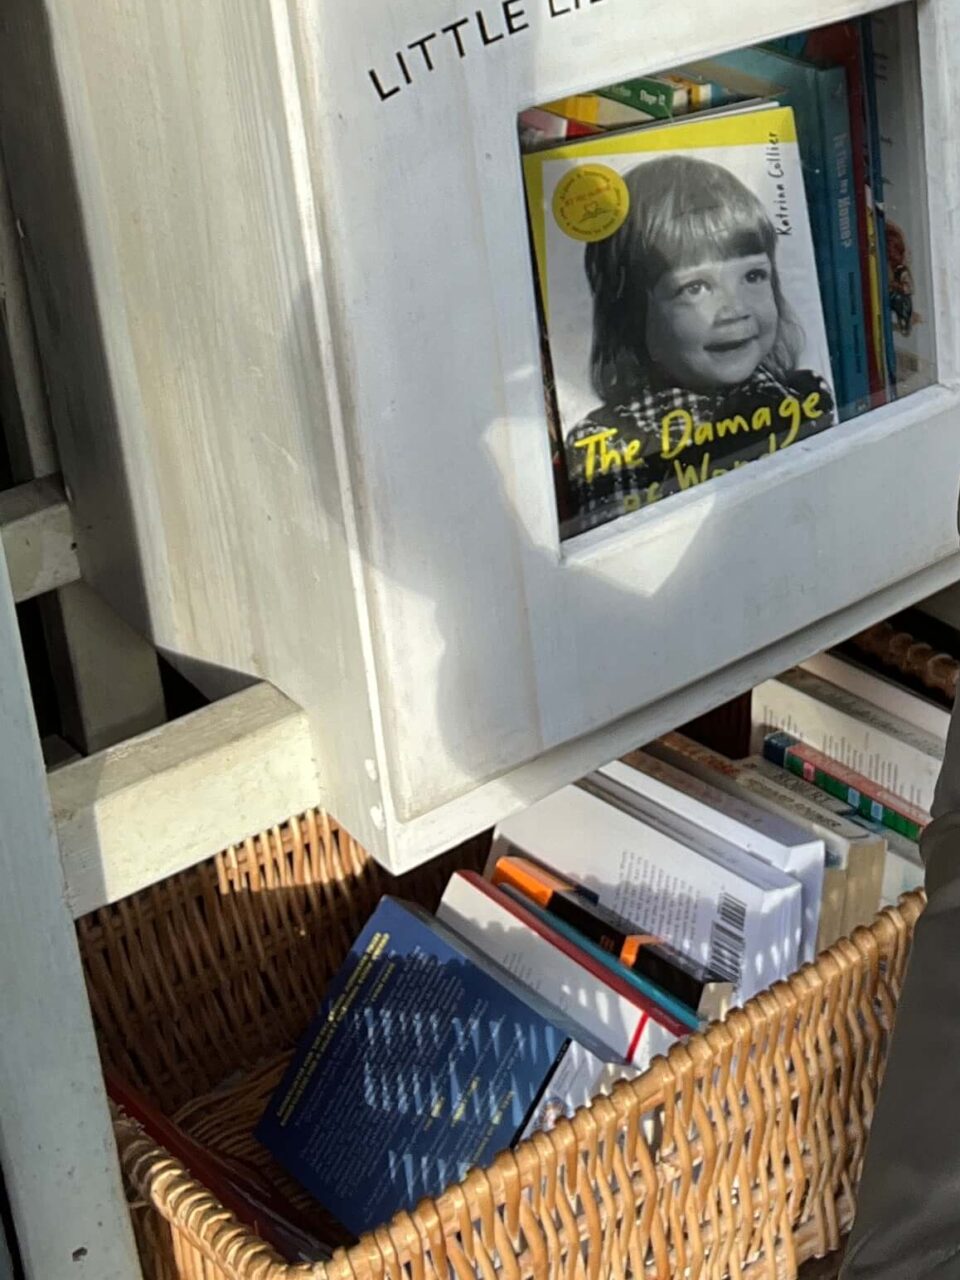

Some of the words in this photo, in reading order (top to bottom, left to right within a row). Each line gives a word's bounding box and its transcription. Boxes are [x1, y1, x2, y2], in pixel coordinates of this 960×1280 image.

[765, 131, 785, 178] Collier
[773, 184, 793, 236] Katrina
[573, 427, 645, 484] The
[660, 391, 824, 459] Damage
